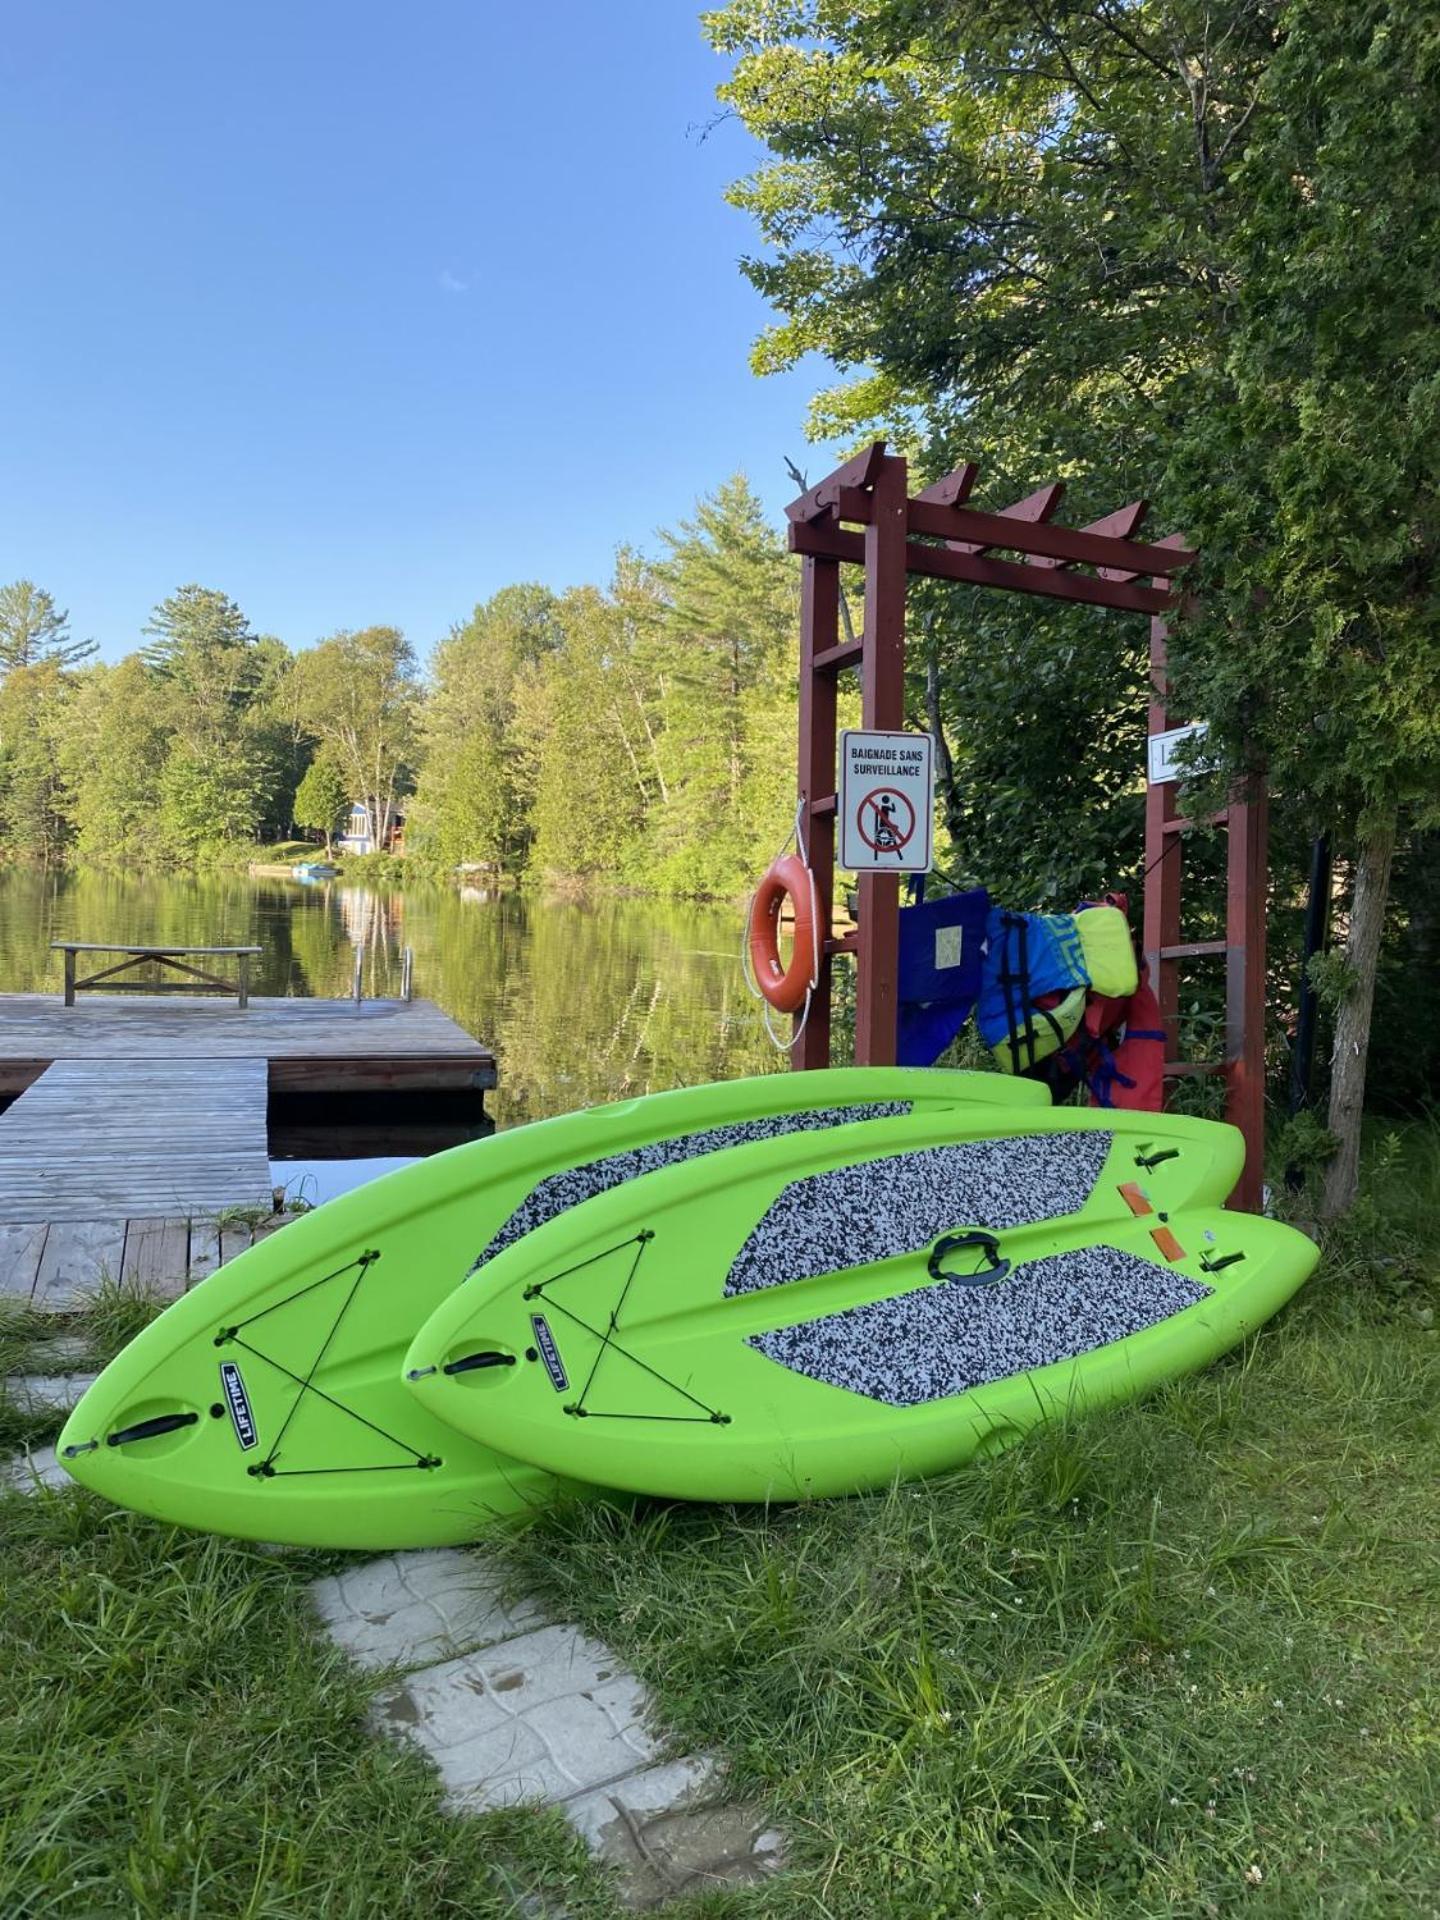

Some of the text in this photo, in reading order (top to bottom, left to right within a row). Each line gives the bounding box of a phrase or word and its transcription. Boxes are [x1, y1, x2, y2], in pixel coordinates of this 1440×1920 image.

[851, 748, 923, 761] BAIGNADE SANS
[854, 764, 920, 776] SURVEILLANCE
[536, 1322, 563, 1381] LIFETIME
[226, 1371, 252, 1439] LIFETIME
